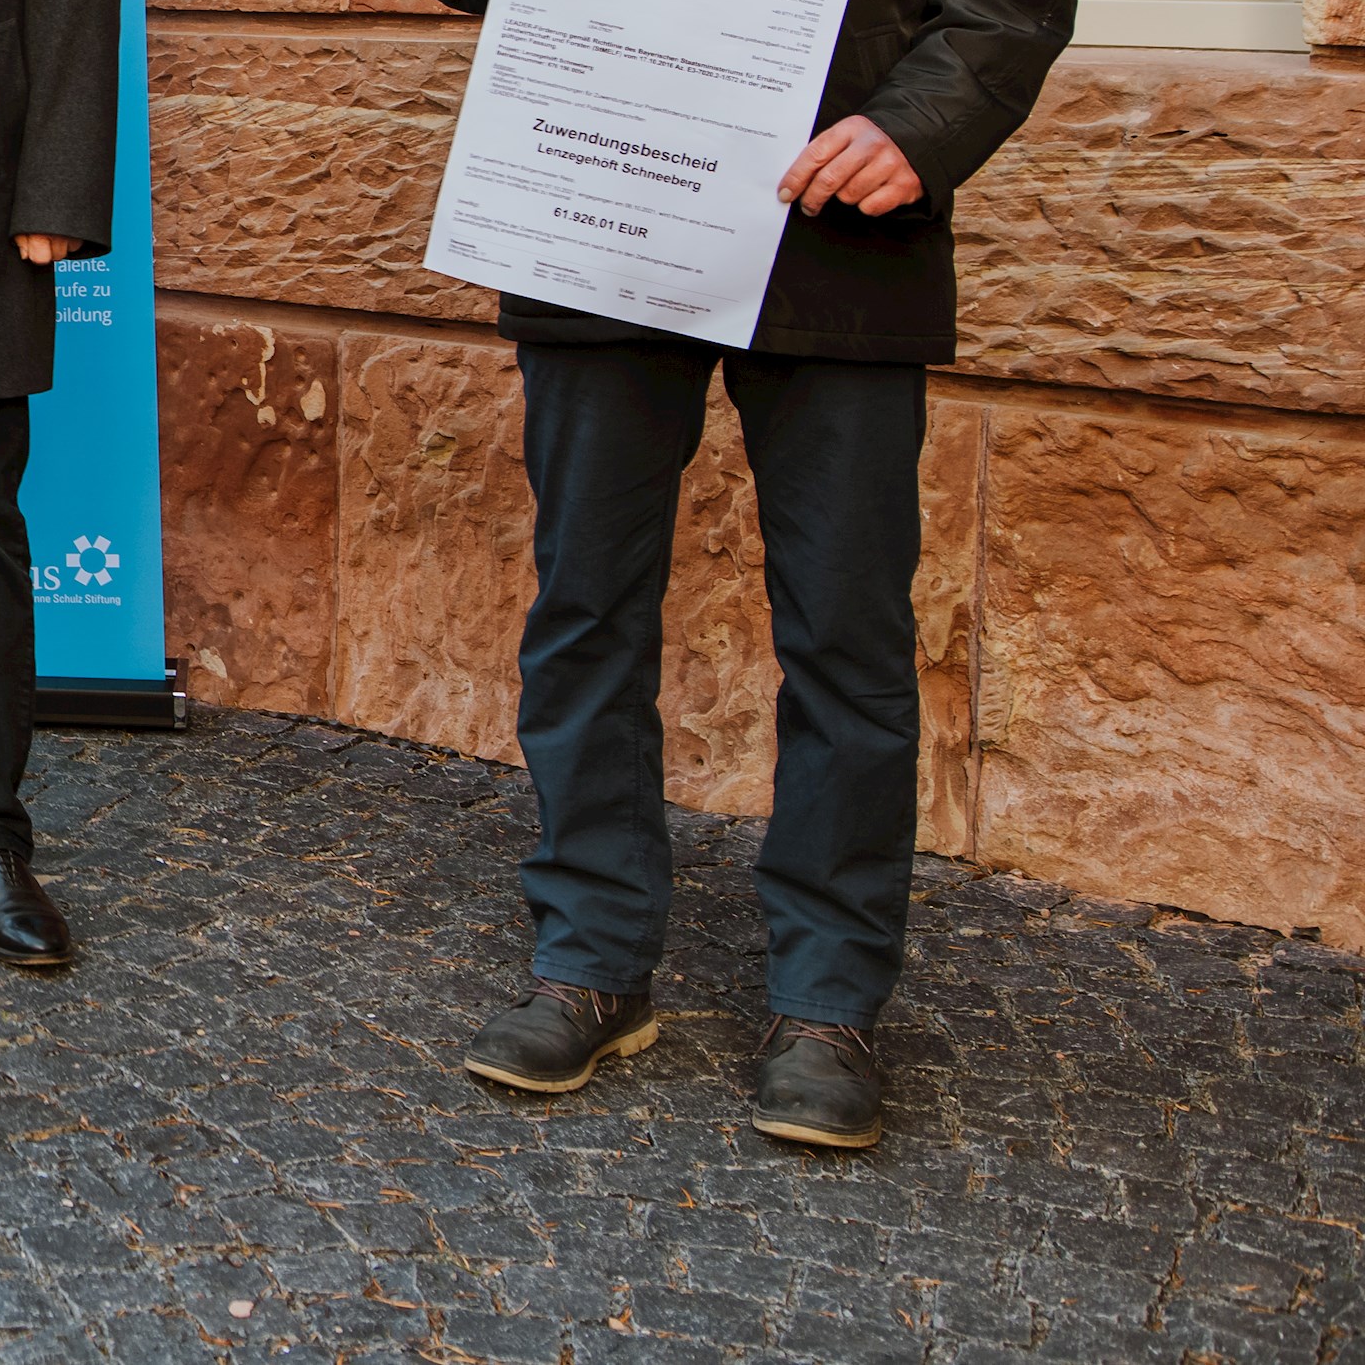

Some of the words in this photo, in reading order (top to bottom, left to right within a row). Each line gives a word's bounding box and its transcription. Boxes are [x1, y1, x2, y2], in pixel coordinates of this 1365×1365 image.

[532, 118, 719, 173] Zuwendungsbescheid
[537, 142, 619, 172] Lenzegehöft
[621, 162, 702, 193] Schneeberg
[553, 207, 615, 231] 61.926,01
[617, 222, 649, 239] EUR
[92, 285, 111, 297] zu
[52, 593, 83, 604] Schulz
[84, 594, 122, 606] Stiftung
